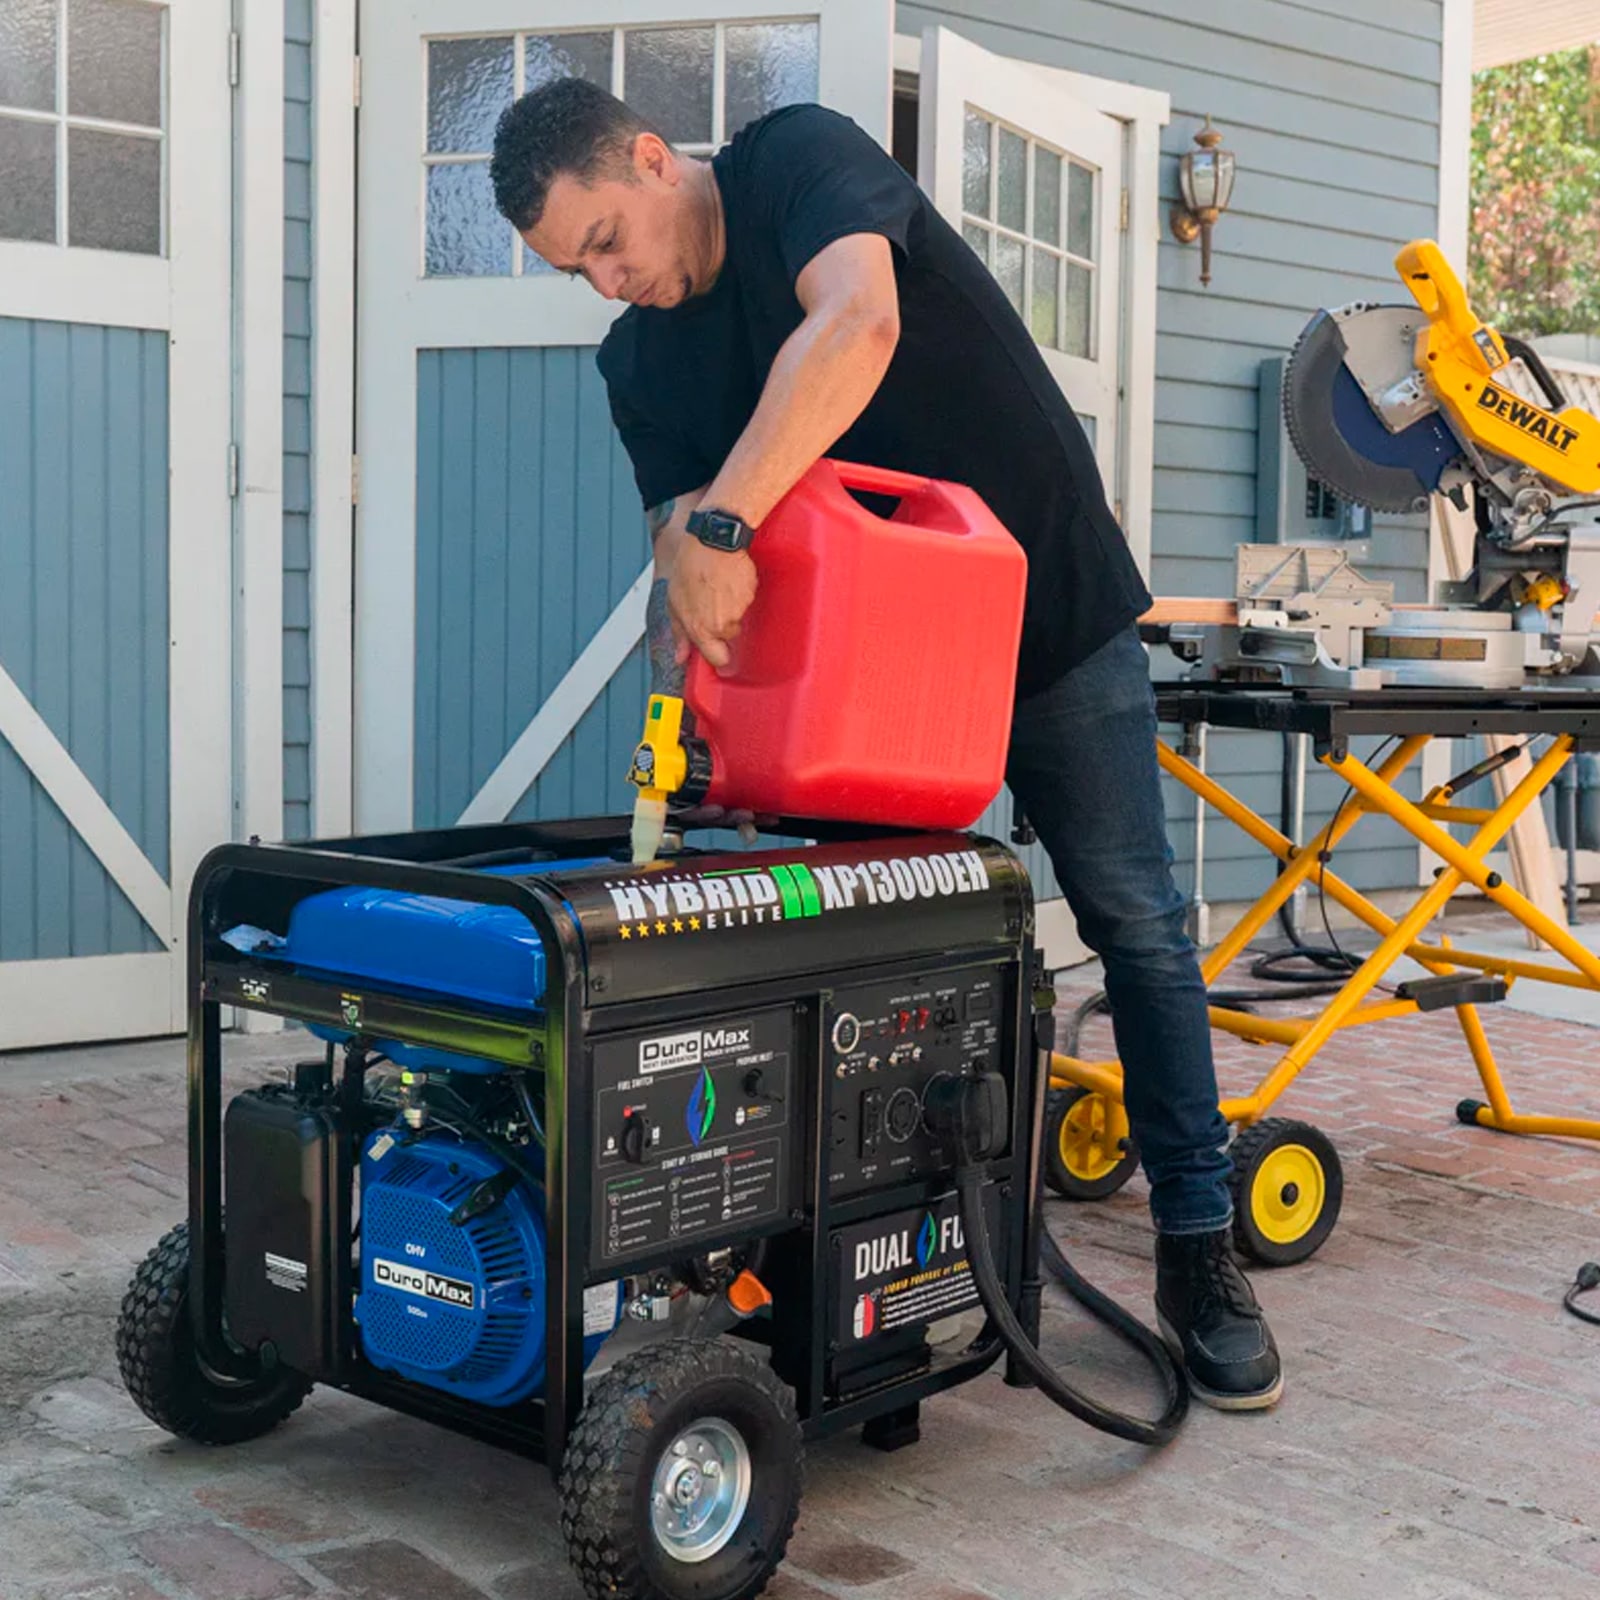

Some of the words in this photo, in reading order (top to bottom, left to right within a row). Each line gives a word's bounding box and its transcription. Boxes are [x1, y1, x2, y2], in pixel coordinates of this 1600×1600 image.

[609, 873, 778, 921] HYBRID
[813, 850, 990, 910] XP13000EH
[706, 904, 781, 930] ELITE
[855, 1230, 913, 1280] DUAL
[940, 1215, 965, 1254] FU
